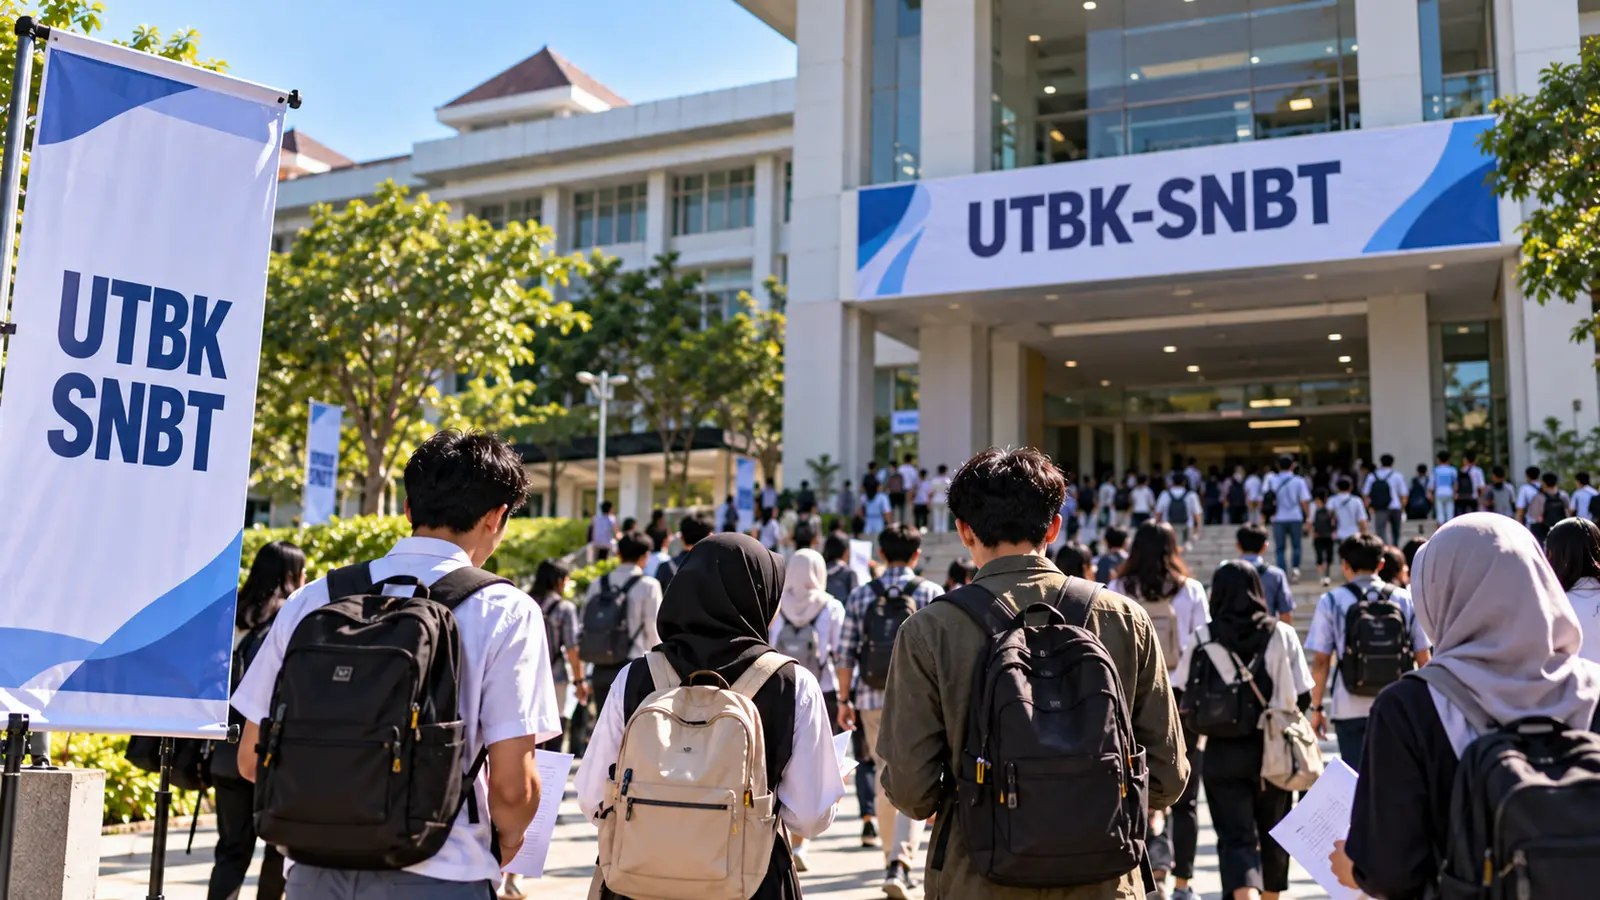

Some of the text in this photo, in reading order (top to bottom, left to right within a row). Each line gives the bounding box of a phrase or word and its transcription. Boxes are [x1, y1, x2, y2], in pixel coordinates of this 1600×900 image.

[967, 159, 1341, 258] UTBK-SNBT
[57, 269, 232, 380] UTBK
[47, 372, 225, 473] SNBT
